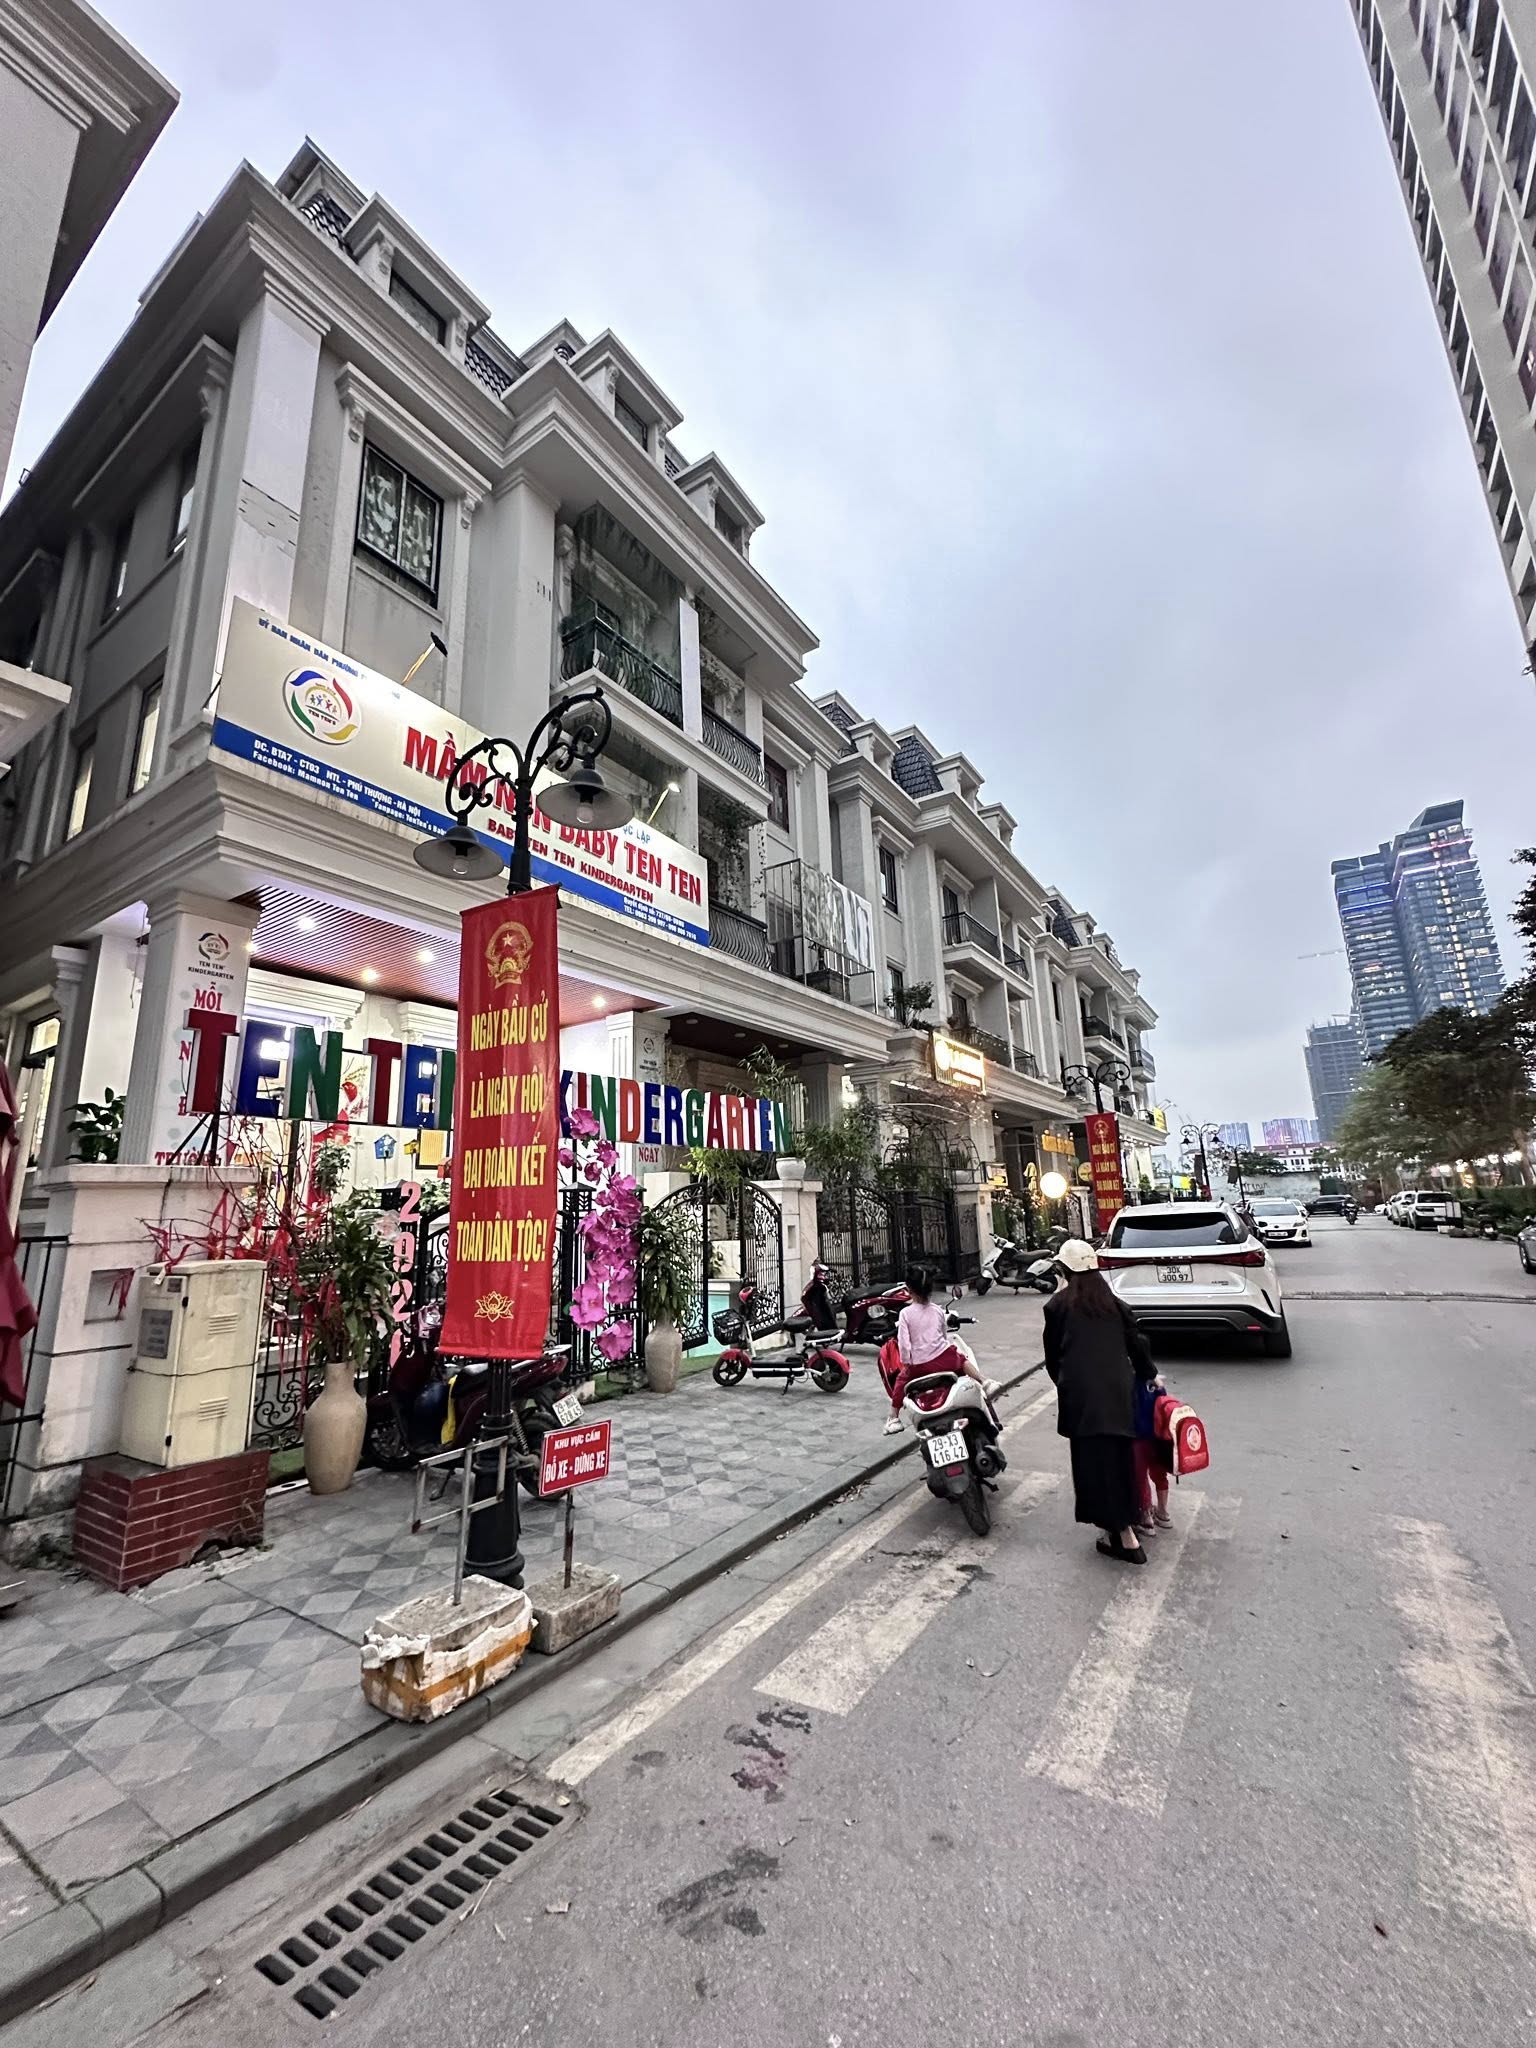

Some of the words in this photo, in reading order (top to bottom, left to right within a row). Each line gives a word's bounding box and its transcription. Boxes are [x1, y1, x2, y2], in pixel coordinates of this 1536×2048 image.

[253, 751, 296, 775] Facebook:
[333, 783, 345, 795] Ten
[346, 789, 359, 801] Ten
[488, 818, 514, 840] BAB
[553, 849, 575, 868] TEN
[580, 861, 654, 903] KINDERGARTEN
[494, 779, 551, 834] NN
[624, 841, 661, 888] TEN
[668, 863, 701, 906] TEN
[188, 966, 234, 980] KINDERGARTEN
[199, 960, 211, 968] TEN
[194, 981, 223, 1011] MỖI
[471, 1003, 500, 1051] NGÀY
[501, 994, 527, 1046] BẦU
[531, 990, 549, 1043] CỬ
[184, 1008, 343, 1121] TEN
[470, 1071, 484, 1119] LÀ
[486, 1067, 518, 1117] NGÀY
[463, 1148, 482, 1198] ĐẠI
[484, 1137, 517, 1188] ĐOÀN
[521, 1131, 547, 1186] KẾT
[457, 1212, 484, 1262] TOÀN
[485, 1211, 513, 1262] DÂN
[517, 1210, 547, 1272] TỘC!
[554, 1437, 570, 1450] KHU
[570, 1434, 584, 1447] VỰC
[585, 1428, 601, 1443] CẤM
[933, 1446, 966, 1465] 416.42
[557, 1459, 568, 1480] XE
[595, 1450, 606, 1470] XE
